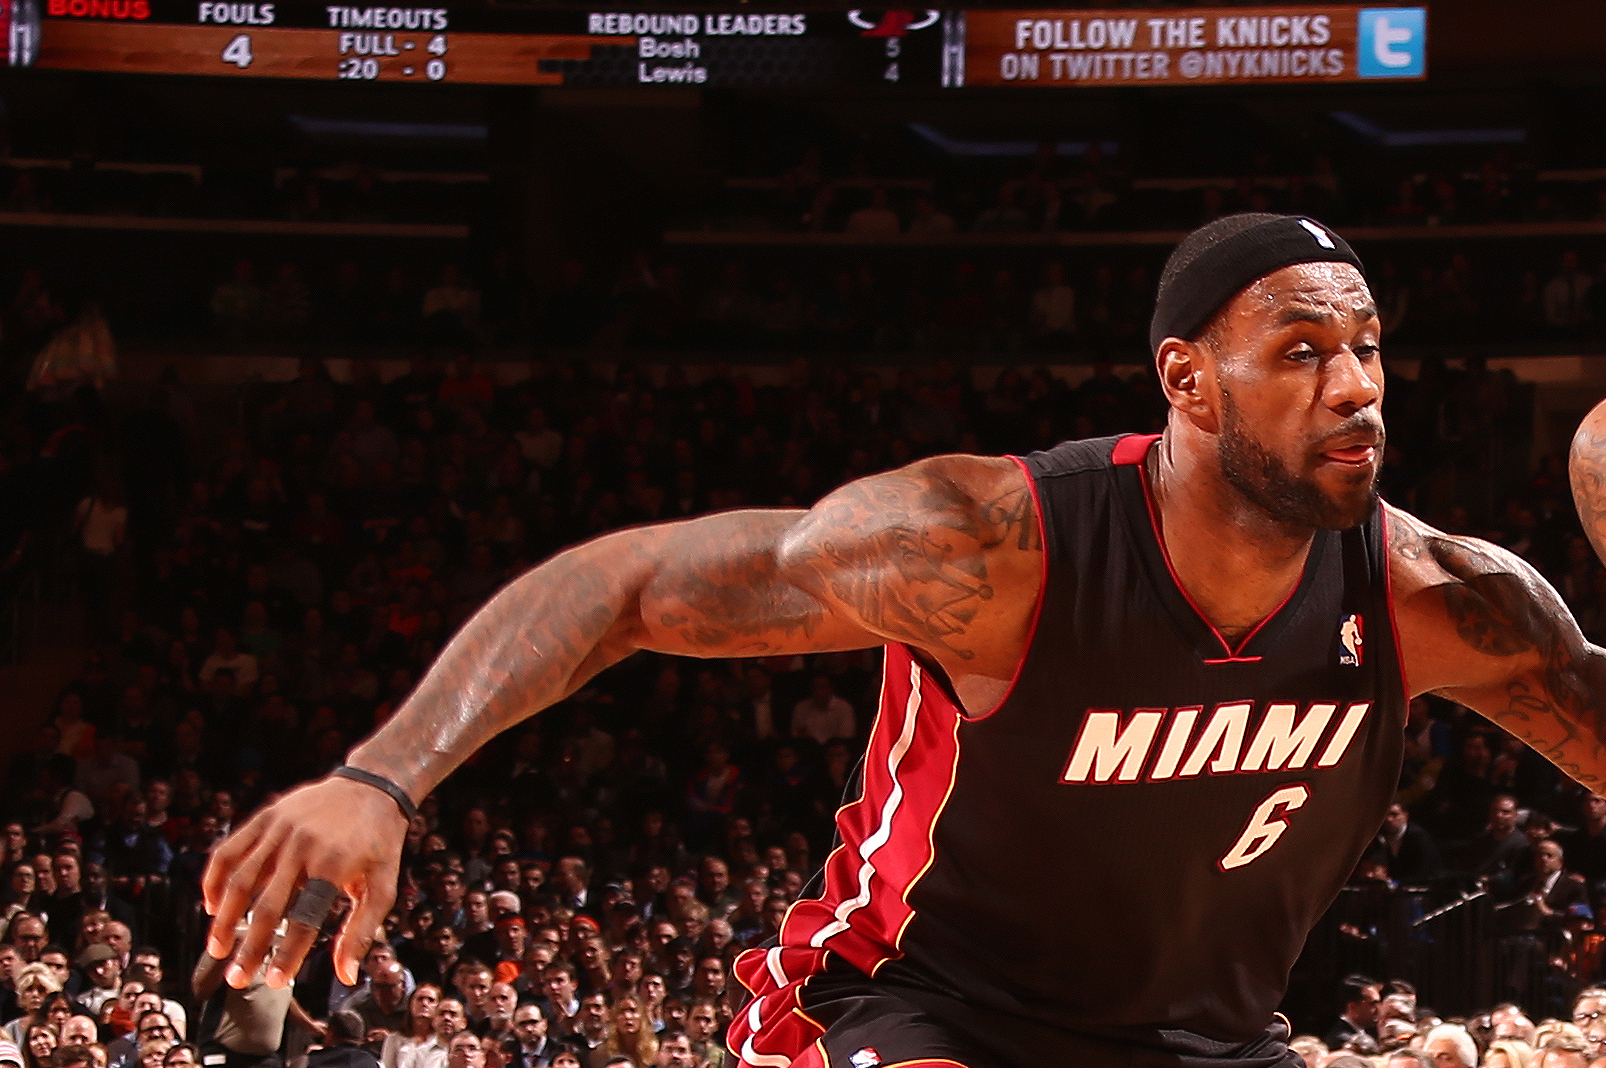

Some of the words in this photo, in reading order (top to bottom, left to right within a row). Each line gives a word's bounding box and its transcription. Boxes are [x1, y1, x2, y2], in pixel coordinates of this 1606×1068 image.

[48, 0, 151, 20] BONUS
[199, 2, 275, 24] FOULS
[326, 6, 448, 30] TIMEOUTS
[588, 13, 699, 35] REBOUND
[705, 14, 807, 35] LEADERS
[1015, 18, 1138, 50] FOLLOW
[1148, 17, 1206, 48] THE
[1216, 15, 1331, 47] KNICKS
[221, 34, 254, 69] 4
[339, 32, 400, 56] FULL
[427, 34, 448, 56] 4
[639, 36, 700, 59] Bosh
[886, 37, 900, 58] 5
[338, 58, 379, 80] :20
[426, 58, 447, 81] 0
[638, 63, 708, 84] Lewis
[884, 62, 899, 82] 4
[1000, 53, 1040, 81] ON
[1048, 51, 1171, 80] TWITTER
[1179, 49, 1345, 79] @NYKNICKS
[1058, 700, 1374, 785] MIAMI
[1217, 782, 1311, 873] 6
